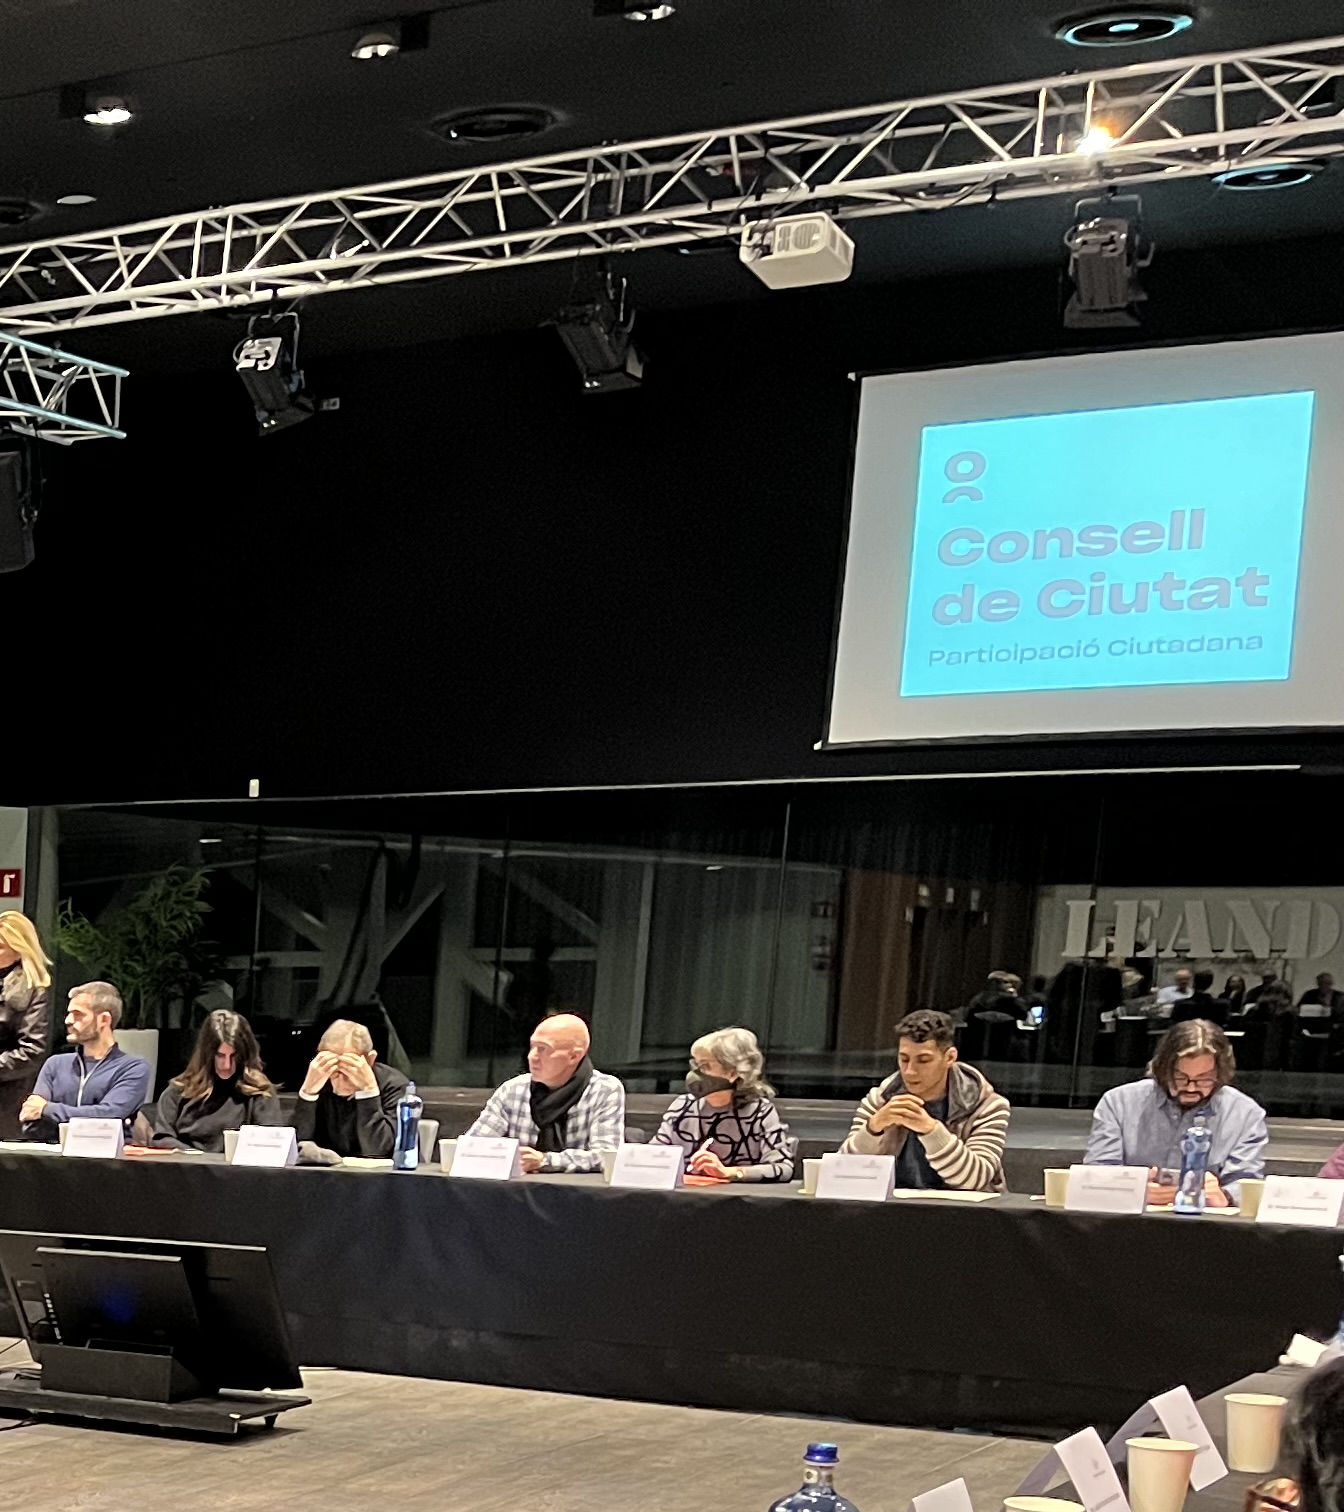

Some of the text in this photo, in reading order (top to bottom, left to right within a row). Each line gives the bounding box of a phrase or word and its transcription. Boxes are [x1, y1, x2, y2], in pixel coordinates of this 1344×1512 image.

[937, 507, 1206, 567] Consell
[931, 566, 1271, 626] de Ciutat
[928, 635, 1264, 667] Participació Ciutadana
